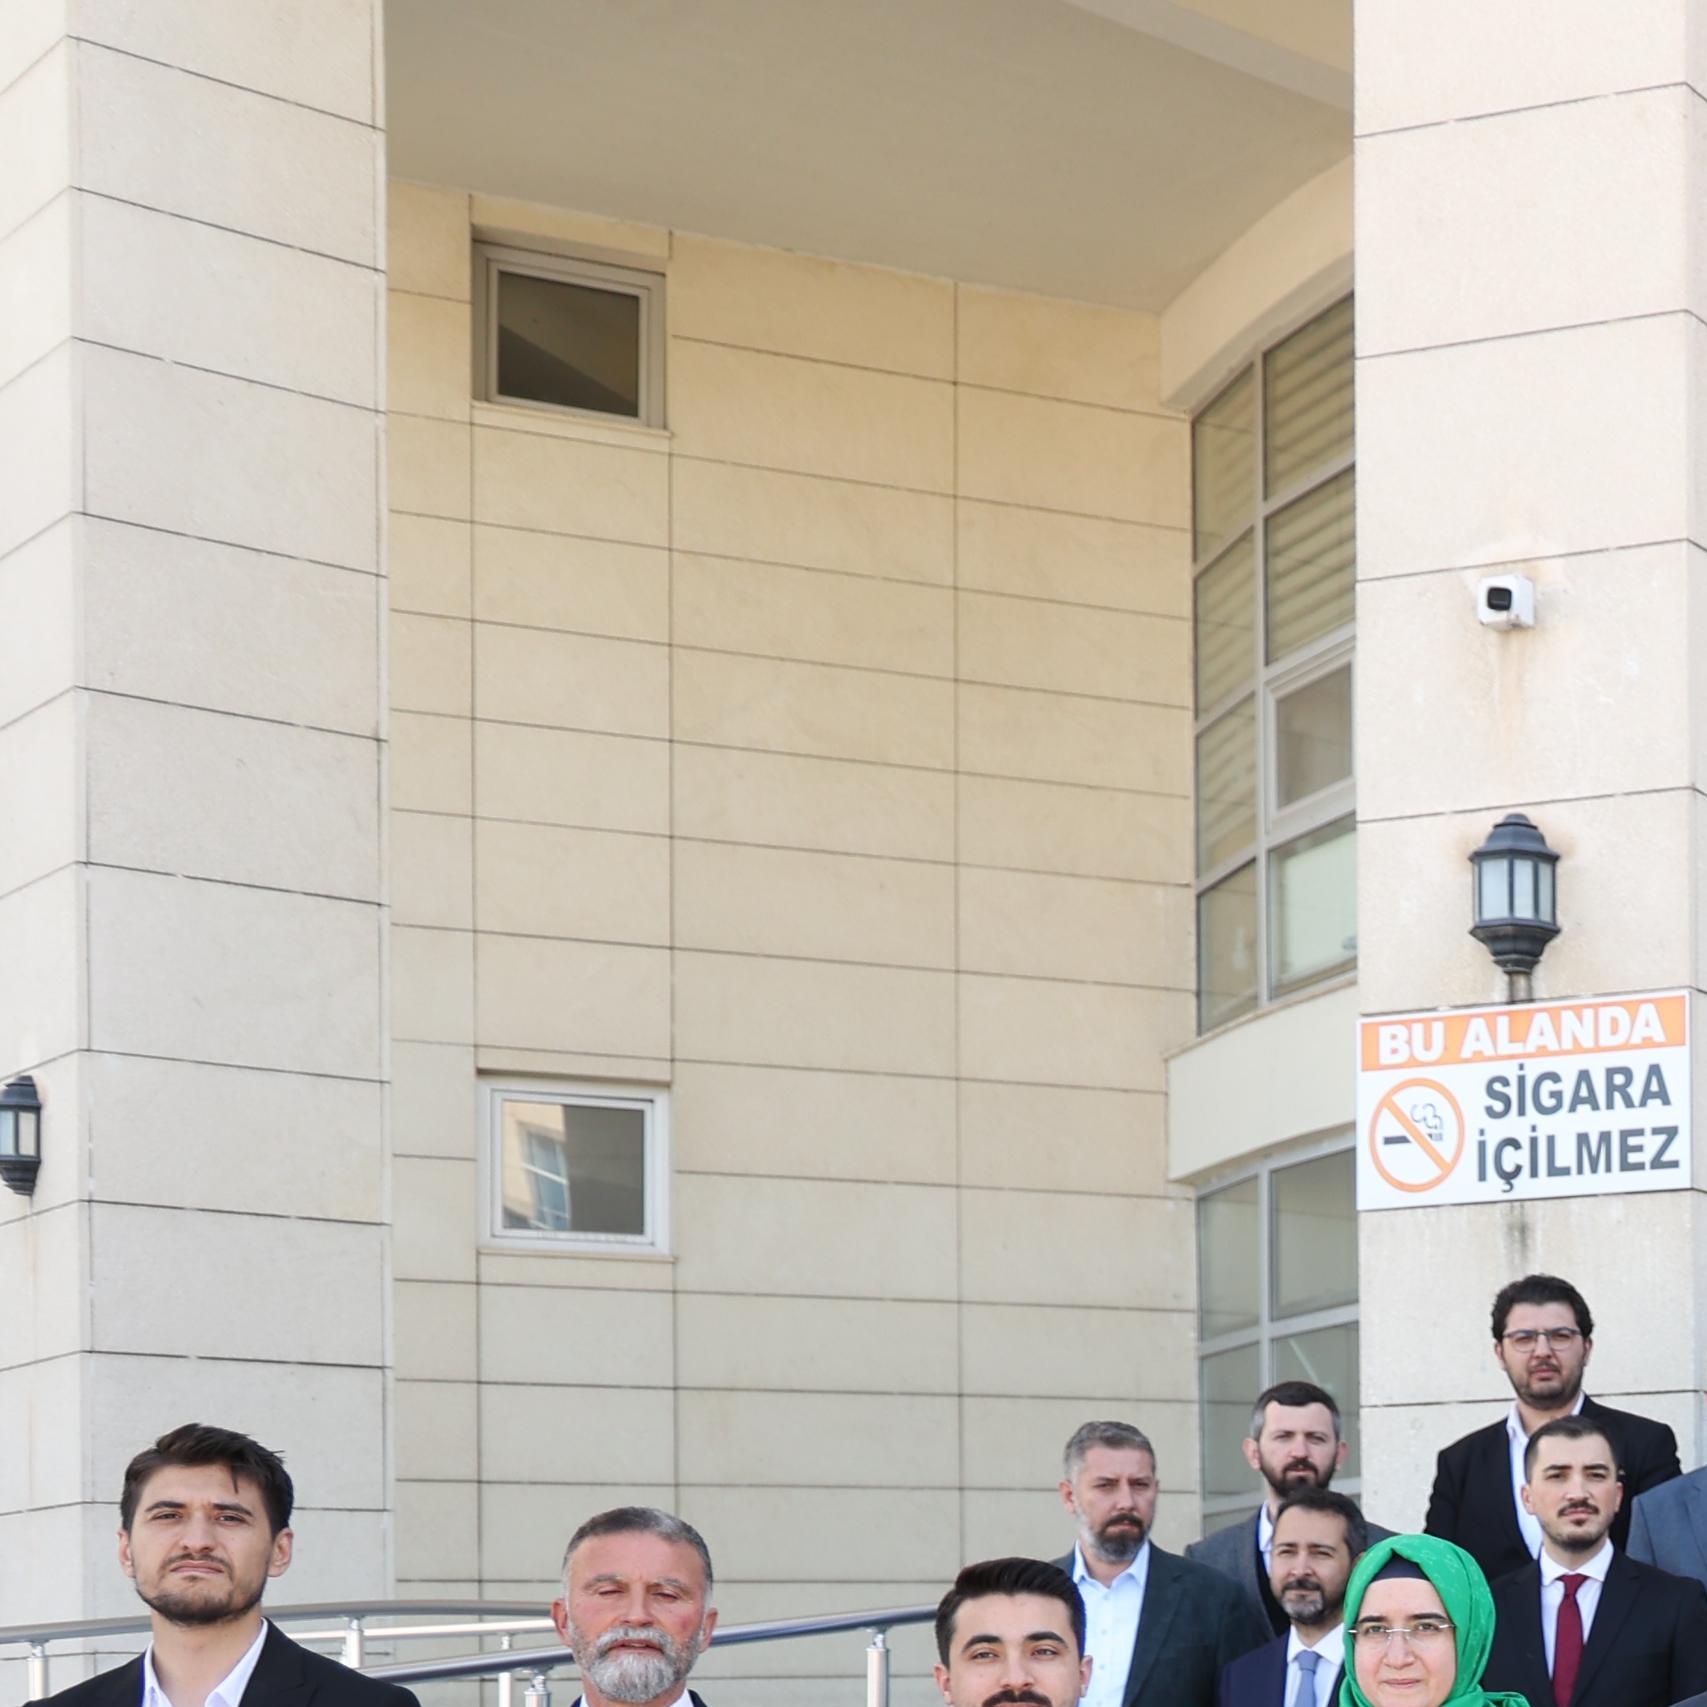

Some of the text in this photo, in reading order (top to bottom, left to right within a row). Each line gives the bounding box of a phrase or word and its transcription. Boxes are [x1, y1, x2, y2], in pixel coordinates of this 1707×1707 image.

[1378, 1002, 1668, 1066] BU ALANDA
[1484, 1062, 1672, 1120] SİGARA
[1476, 1124, 1681, 1194] İÇİLMEZ
